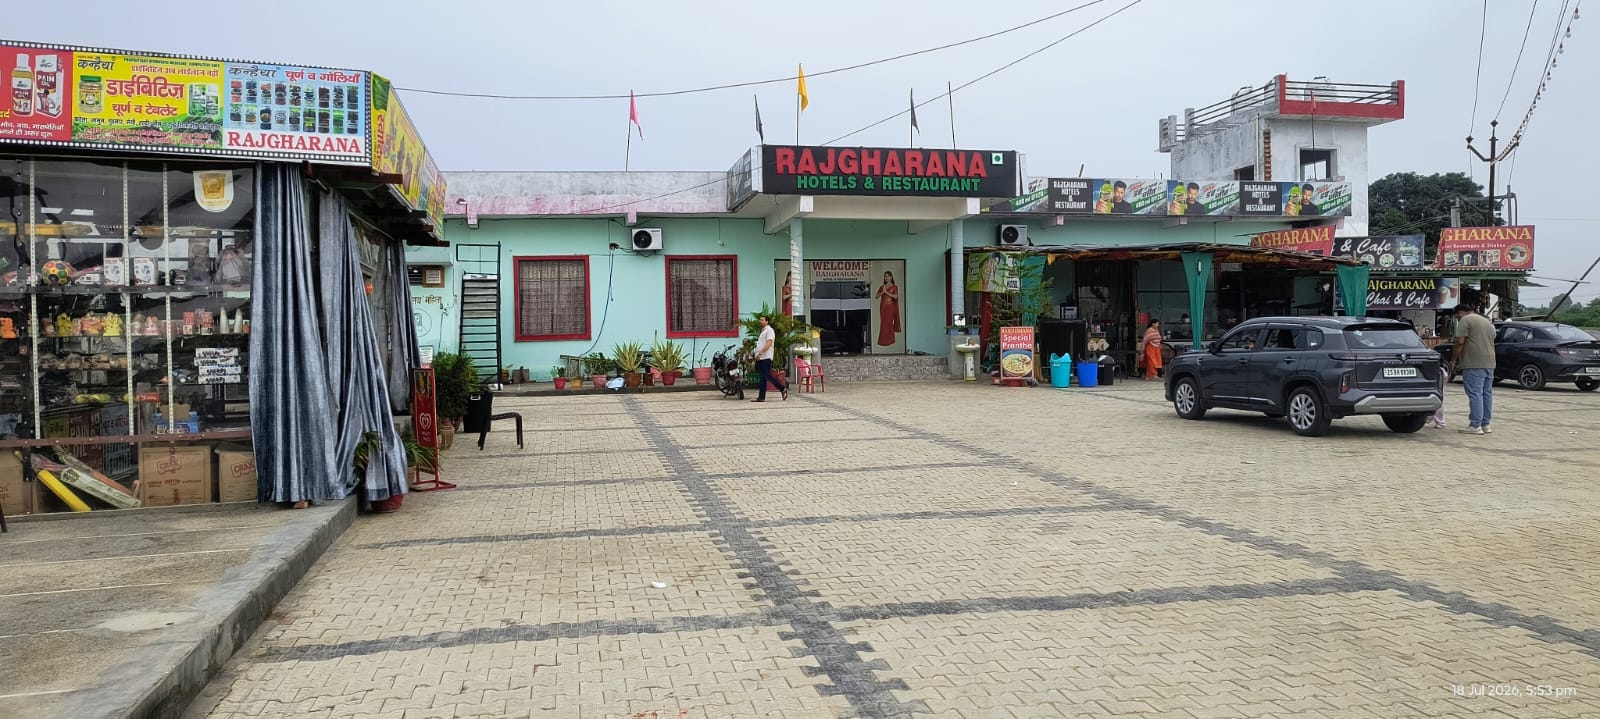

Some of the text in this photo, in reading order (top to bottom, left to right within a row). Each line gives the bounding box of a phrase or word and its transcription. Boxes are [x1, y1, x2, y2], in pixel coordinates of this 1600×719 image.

[285, 69, 304, 81] चूर्ण
[134, 106, 142, 114] व
[228, 131, 361, 154] RAJGHARANA
[775, 147, 988, 178] RAJGHARANA
[797, 175, 981, 191] HOTELS & RESTAURANT
[1054, 201, 1087, 209] RESTAURANT
[1442, 228, 1532, 241] GHARANA
[1340, 239, 1352, 251] &
[1357, 238, 1392, 255] Cafe
[812, 261, 869, 271] WELCOME
[1367, 279, 1436, 291] AJGHARANA
[1365, 291, 1431, 308] Chai & Cafe
[1003, 334, 1031, 342] Special
